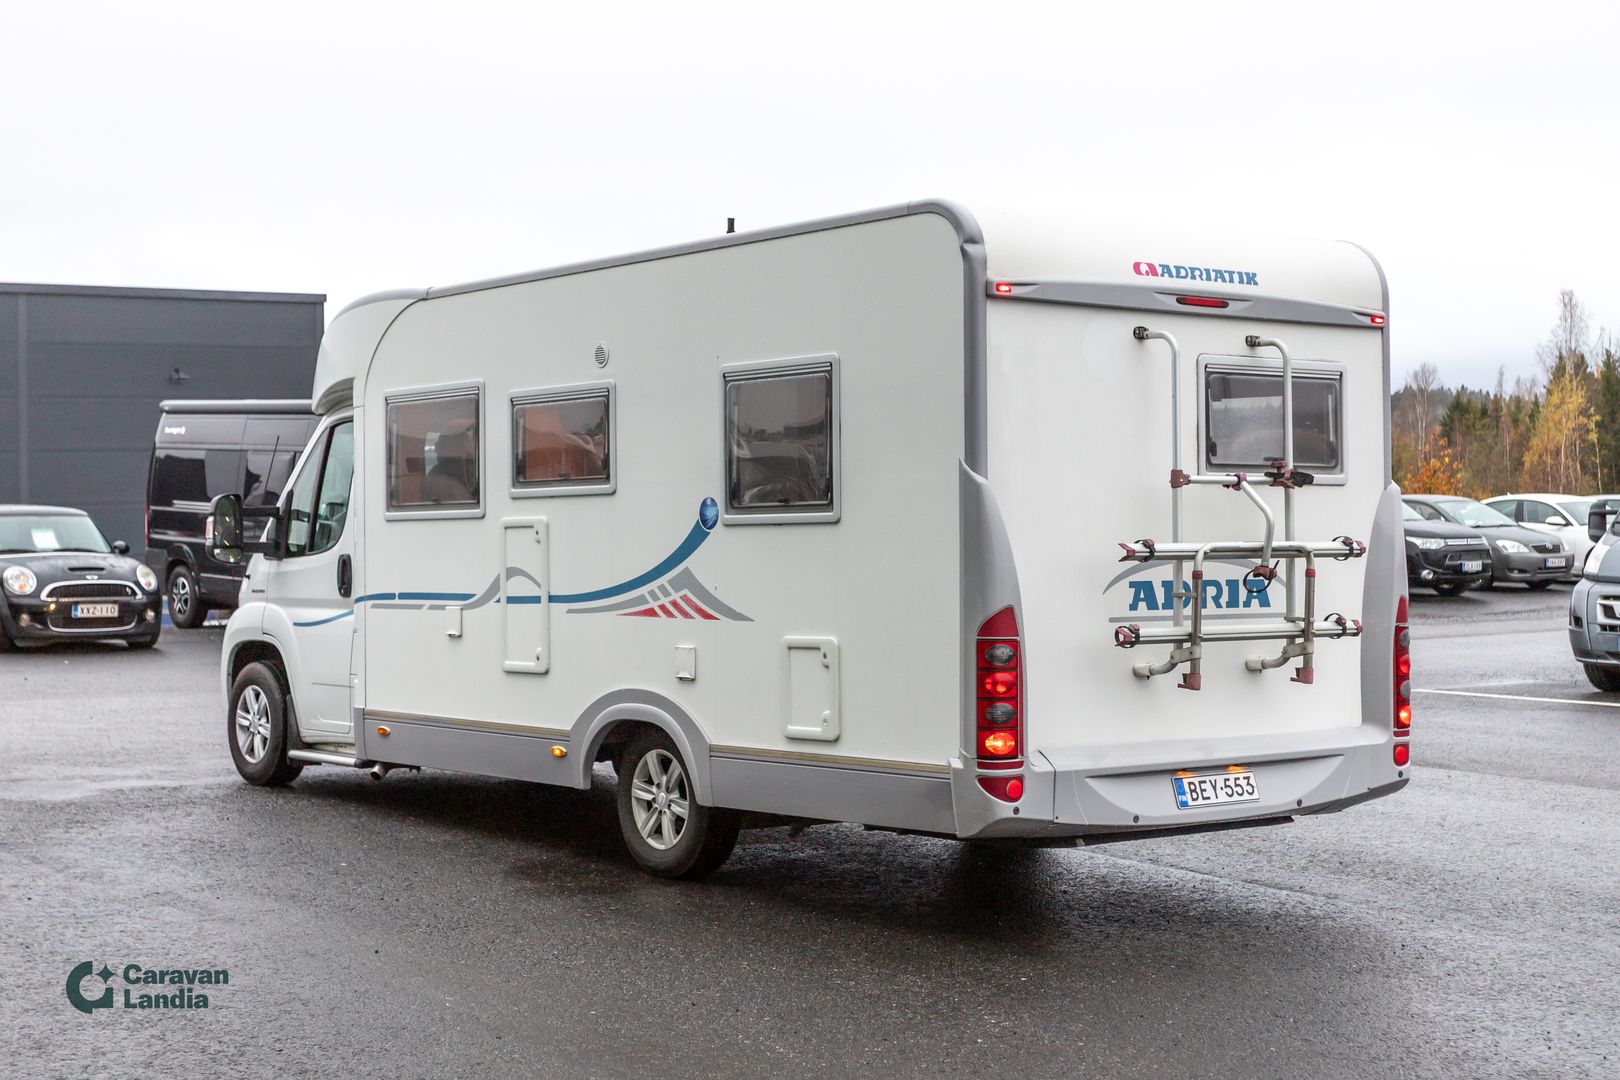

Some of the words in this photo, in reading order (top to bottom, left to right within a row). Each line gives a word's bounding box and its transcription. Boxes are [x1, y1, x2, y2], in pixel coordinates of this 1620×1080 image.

[1158, 263, 1259, 286] ADRIATIK
[1128, 578, 1271, 612] ADRIA
[1187, 775, 1256, 802] BEY-553
